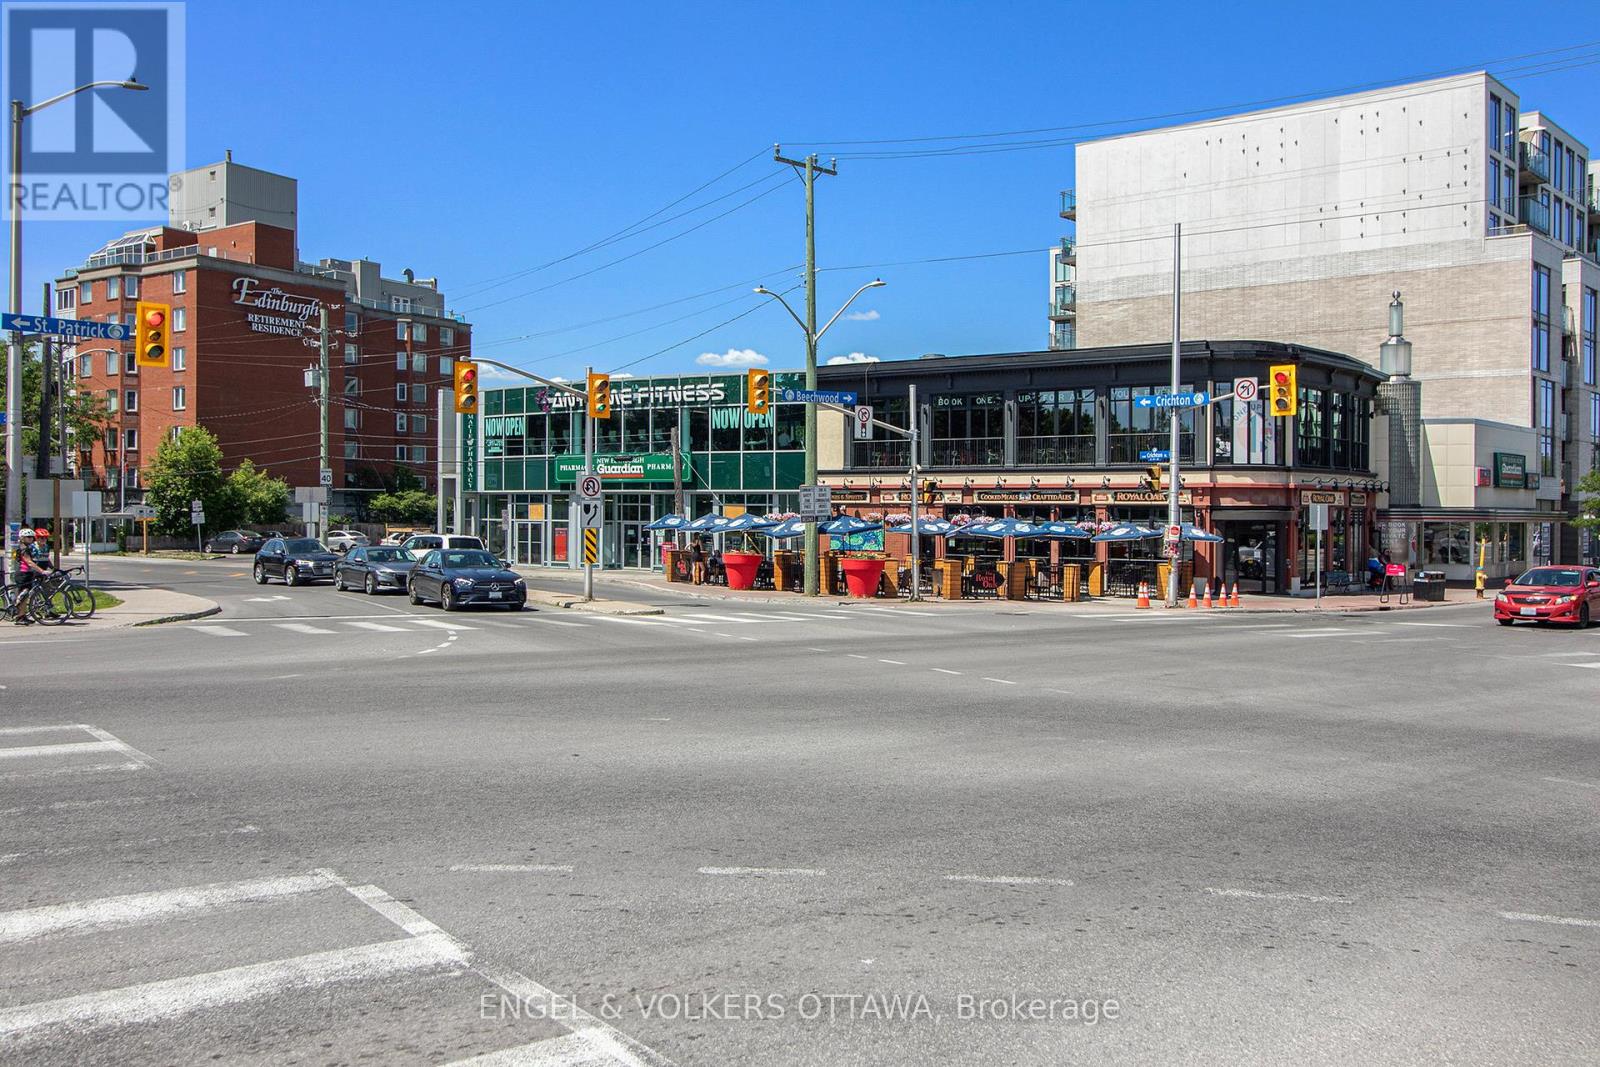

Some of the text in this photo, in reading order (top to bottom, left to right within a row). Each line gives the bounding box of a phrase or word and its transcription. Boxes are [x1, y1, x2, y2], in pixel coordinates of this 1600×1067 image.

[232, 277, 320, 320] Edinburgh
[34, 317, 104, 338] St. Patrick
[247, 313, 307, 329] RETIREMENT
[251, 322, 303, 337] RESIDENCE
[638, 382, 725, 404] FITNESS
[796, 390, 839, 403] Beechwood
[938, 397, 963, 406] BOOK
[1155, 395, 1191, 407] Crichton
[711, 407, 774, 430] NOW OPEN
[485, 417, 525, 437] NOW OPEN
[596, 463, 644, 474] Guardian
[321, 474, 332, 482] 40
[1117, 492, 1145, 501] ROYAL
[1145, 491, 1167, 501] OAK
